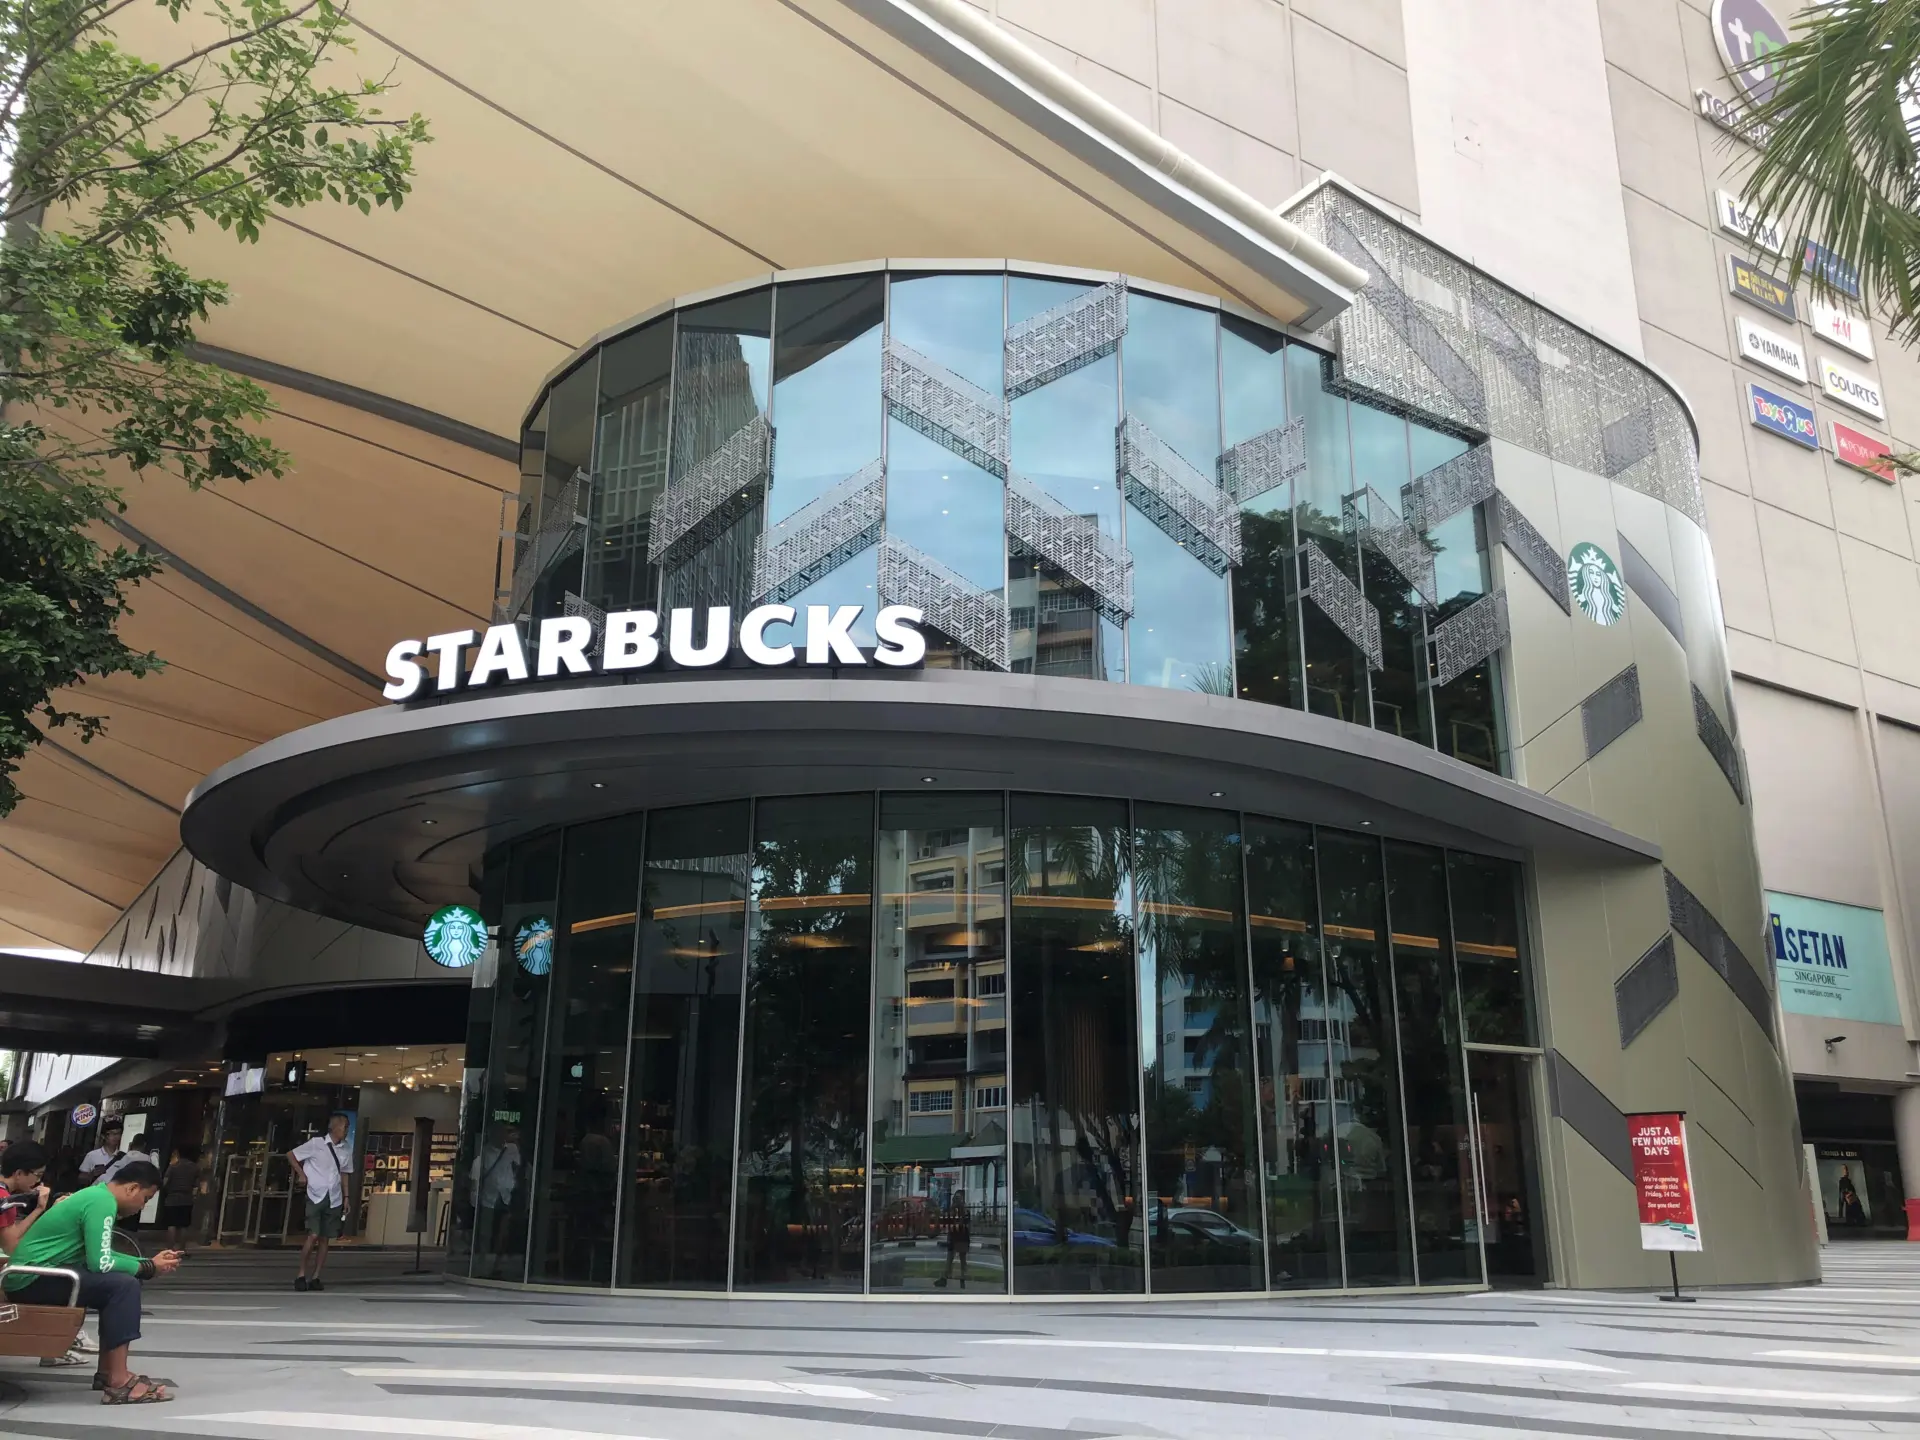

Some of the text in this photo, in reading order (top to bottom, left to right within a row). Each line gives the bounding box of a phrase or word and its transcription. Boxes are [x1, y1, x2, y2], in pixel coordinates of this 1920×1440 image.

[1760, 338, 1800, 370] YAMAHA
[1829, 371, 1880, 407] COURTS
[382, 604, 927, 701] STARBUCKS
[1770, 912, 1848, 969] ISETAN
[1794, 970, 1837, 986] SINGAPORE
[1793, 987, 1843, 1001] www.isetan.com.sg
[75, 1111, 94, 1123] KING
[1638, 1126, 1671, 1136] JUST A
[1632, 1136, 1680, 1146] FEW MORE
[1644, 1146, 1670, 1156] DAYS
[1658, 1176, 1679, 1184] opening
